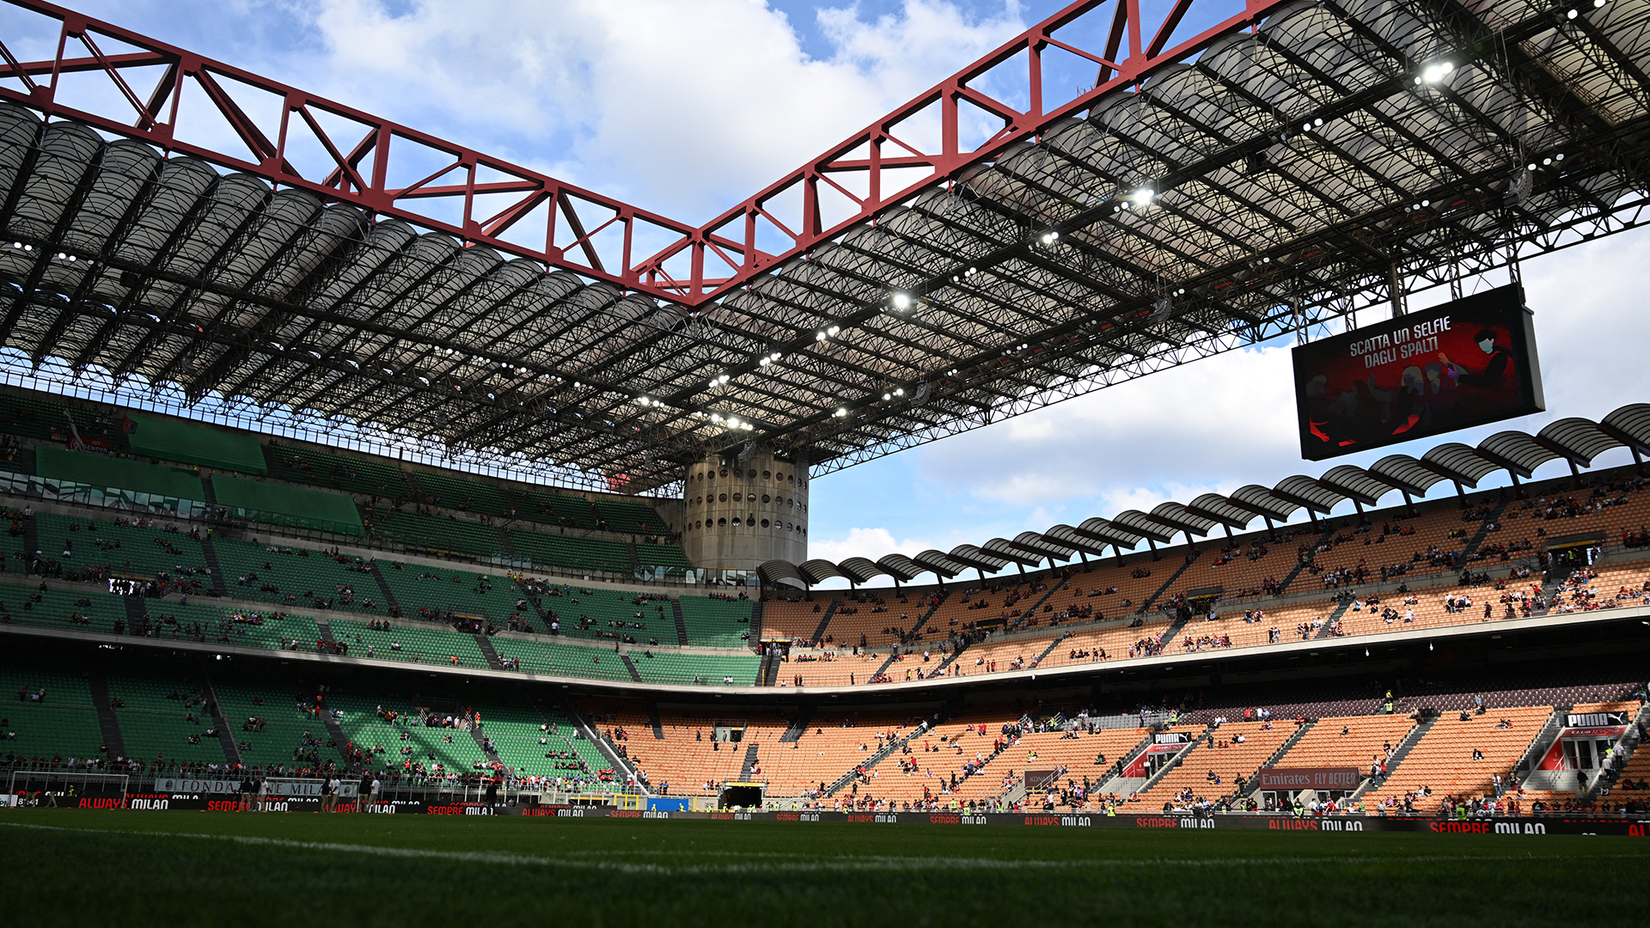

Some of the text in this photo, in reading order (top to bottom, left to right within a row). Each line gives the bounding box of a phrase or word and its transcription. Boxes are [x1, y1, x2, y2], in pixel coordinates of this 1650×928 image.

[1350, 316, 1451, 356] SCATTA UN SELFIE
[1364, 336, 1438, 368] DAGLI SPALTI
[1568, 713, 1608, 726] PUMA
[1156, 733, 1180, 743] PUMA
[1262, 772, 1356, 785] Emirates FLY BETTER
[131, 799, 168, 809] MILAN
[427, 806, 463, 815] SEMPRE
[522, 808, 584, 817] ALWAYS MILAN
[962, 816, 986, 824] MILAN
[1062, 817, 1090, 826] MILAN
[1181, 818, 1215, 828] MILAN
[1322, 820, 1363, 831] MILAN
[1495, 822, 1546, 835] MILAN
